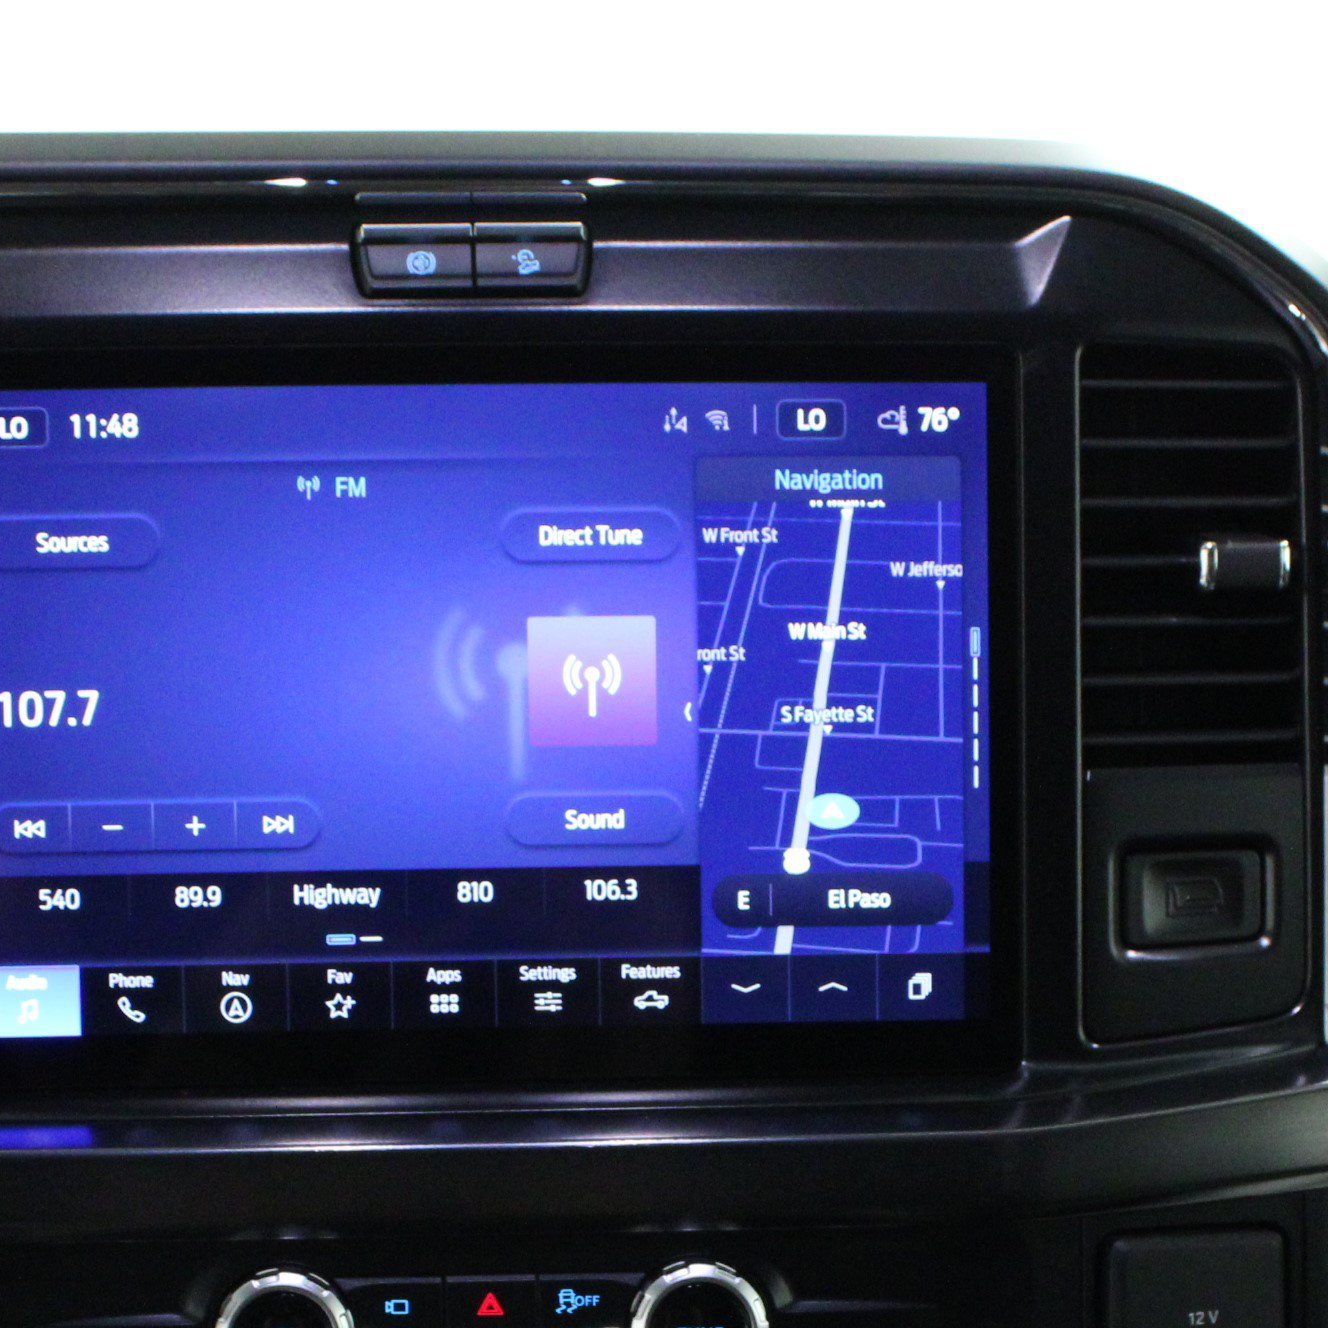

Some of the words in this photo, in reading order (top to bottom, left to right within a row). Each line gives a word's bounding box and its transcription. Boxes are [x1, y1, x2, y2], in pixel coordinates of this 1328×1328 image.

[70, 413, 140, 439] 11:48
[795, 408, 827, 432] LO
[335, 477, 367, 499] FM
[774, 468, 884, 494] Navigation
[35, 532, 110, 554] Sources
[538, 524, 594, 547] Direct
[594, 524, 644, 547] Tune
[702, 528, 719, 543] W
[722, 527, 759, 543] Front
[761, 526, 778, 543] St
[890, 562, 906, 577] W
[788, 623, 805, 640] W
[806, 622, 846, 640] Main
[847, 622, 866, 640] St
[729, 645, 746, 662] St
[780, 705, 793, 723] S
[794, 705, 854, 726] Fayette
[856, 705, 875, 723] St
[564, 809, 626, 833] Sound
[38, 887, 81, 912] 540
[174, 884, 223, 910] 89.9
[293, 883, 382, 910] Highway
[456, 880, 495, 904] 810
[583, 878, 639, 902] 106.3
[737, 889, 751, 911] E
[827, 888, 846, 909] El
[847, 888, 892, 909] Paso
[108, 972, 154, 992] Phone
[221, 970, 250, 987] Nav
[326, 968, 353, 986] Fav
[426, 967, 462, 989] Apps
[518, 964, 577, 986] Settings
[620, 962, 682, 981] Features
[574, 1294, 600, 1308] OFF
[1188, 1312, 1205, 1326] 12
[1206, 1310, 1219, 1325] V
